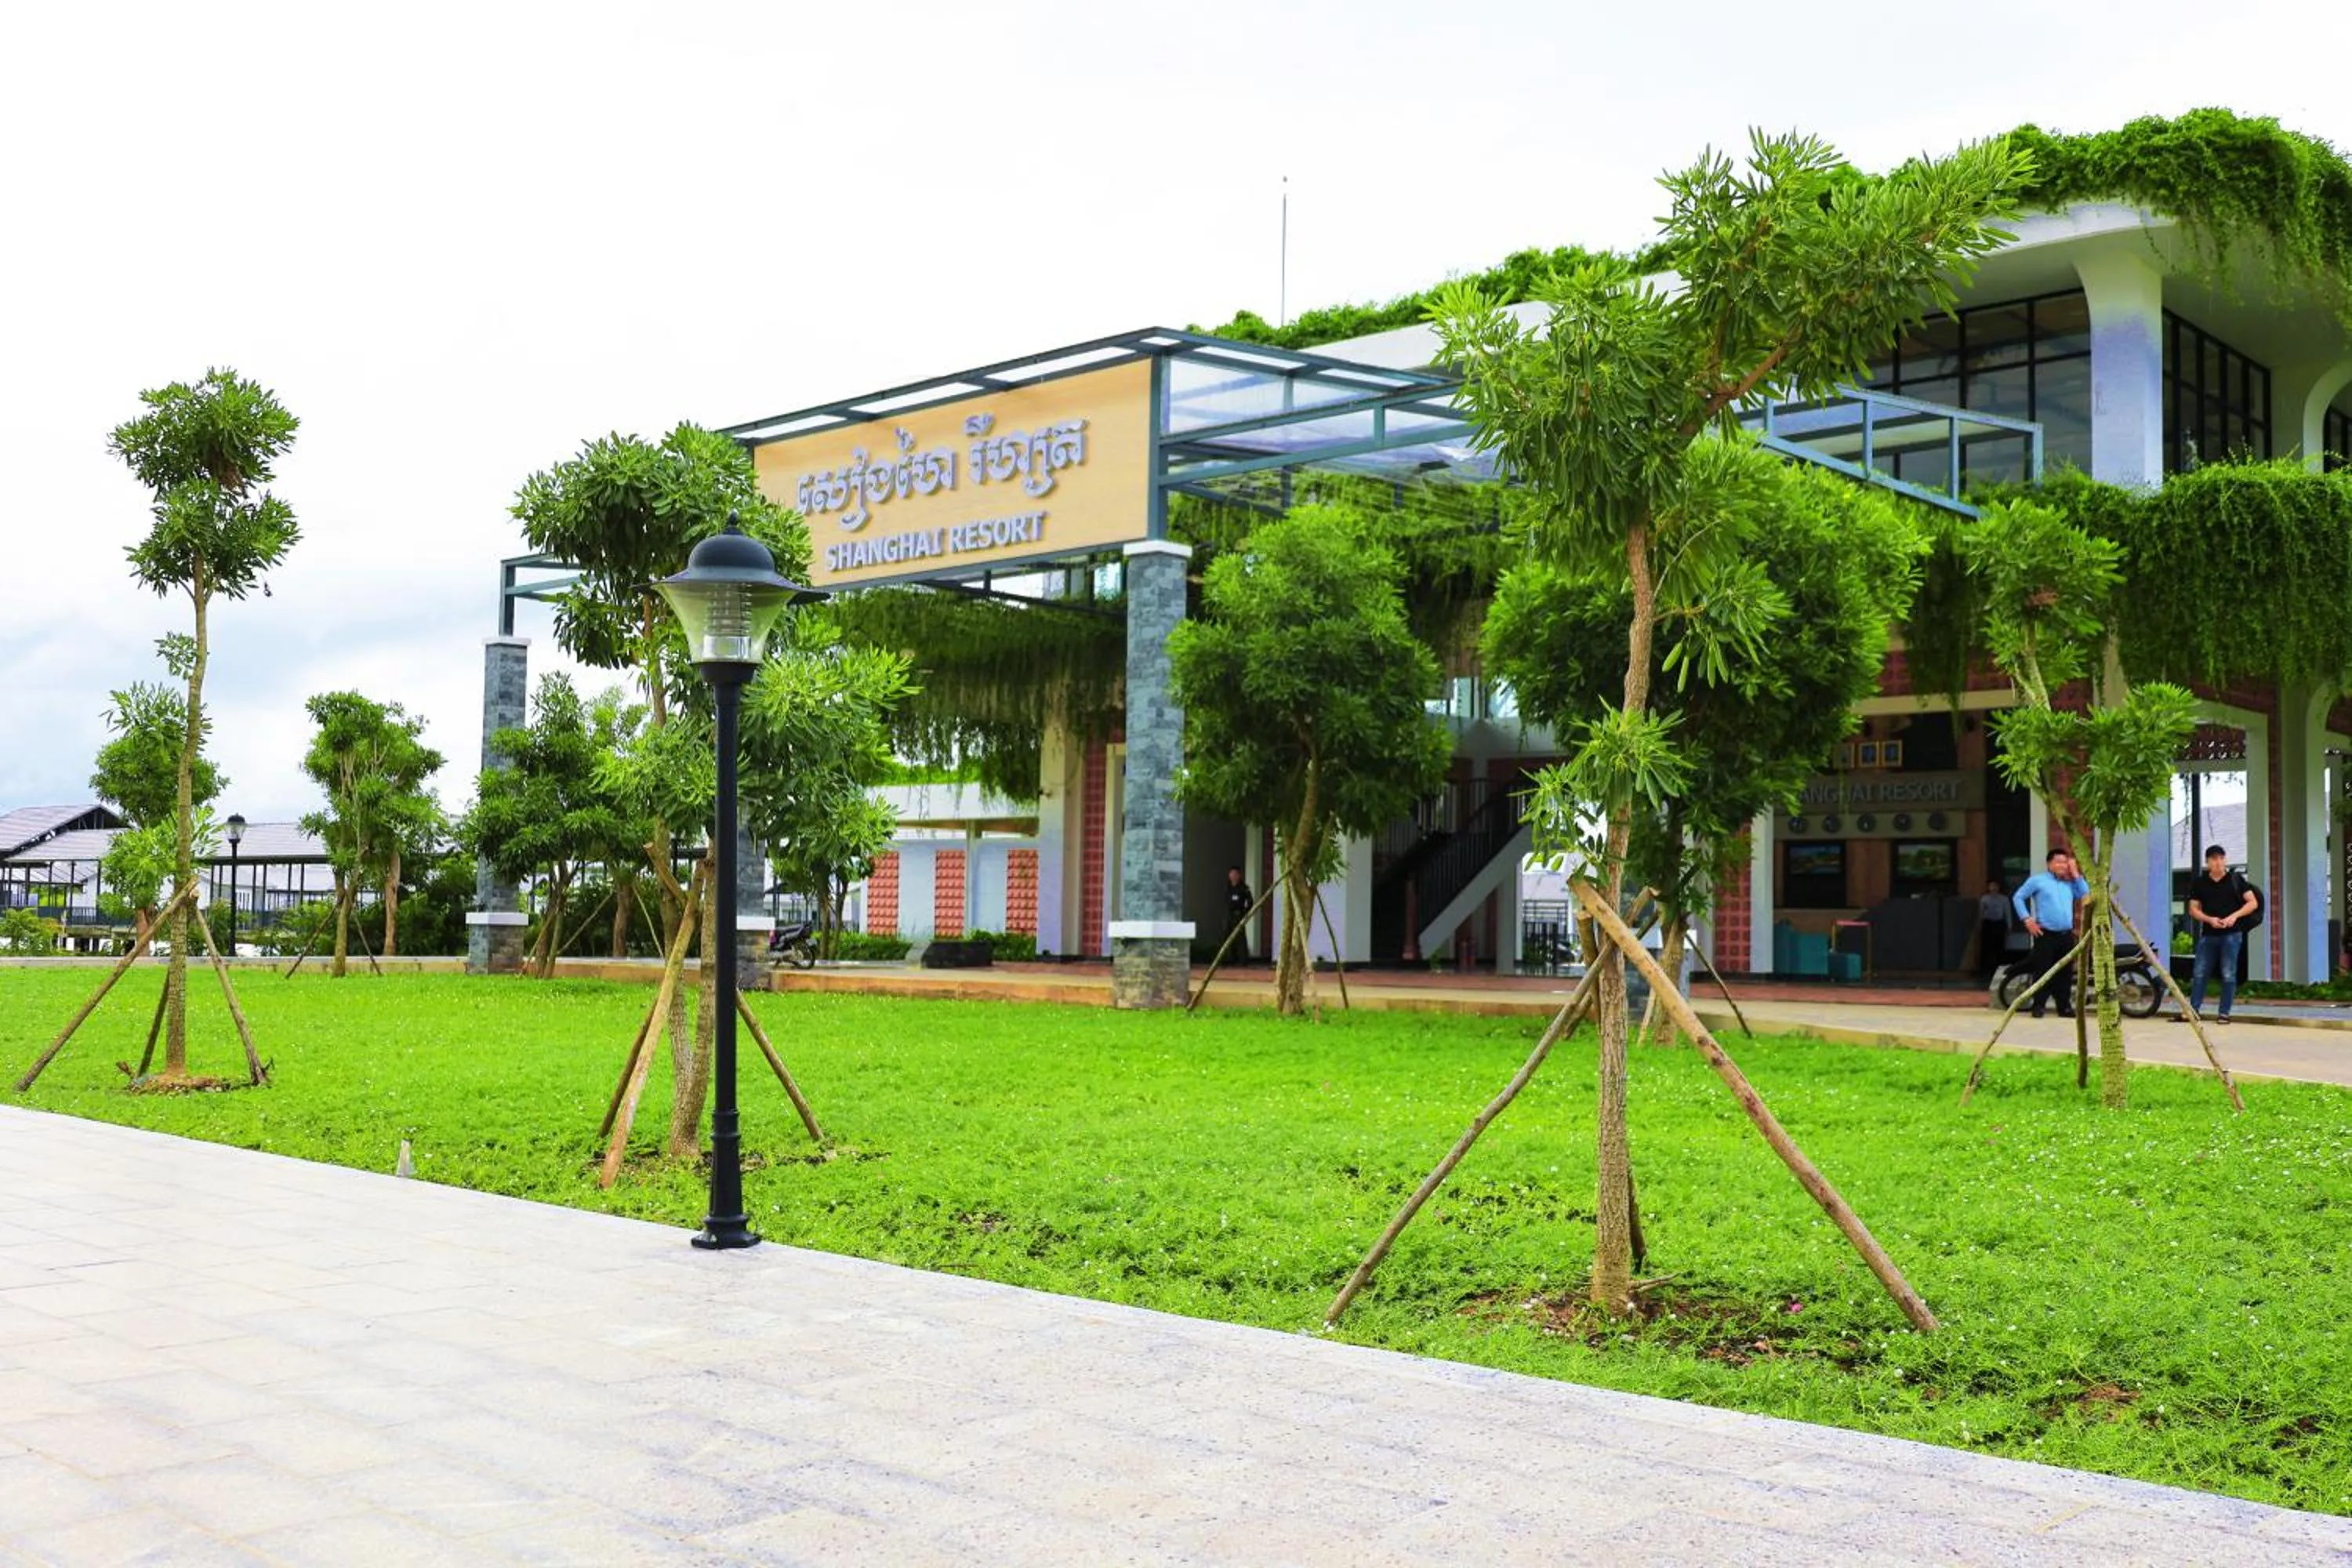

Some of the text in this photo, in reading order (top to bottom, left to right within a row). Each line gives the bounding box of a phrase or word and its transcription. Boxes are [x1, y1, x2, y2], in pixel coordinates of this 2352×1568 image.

[826, 510, 1047, 572] SHANGHAI RESORT
[1879, 780, 1961, 803] RESORT
